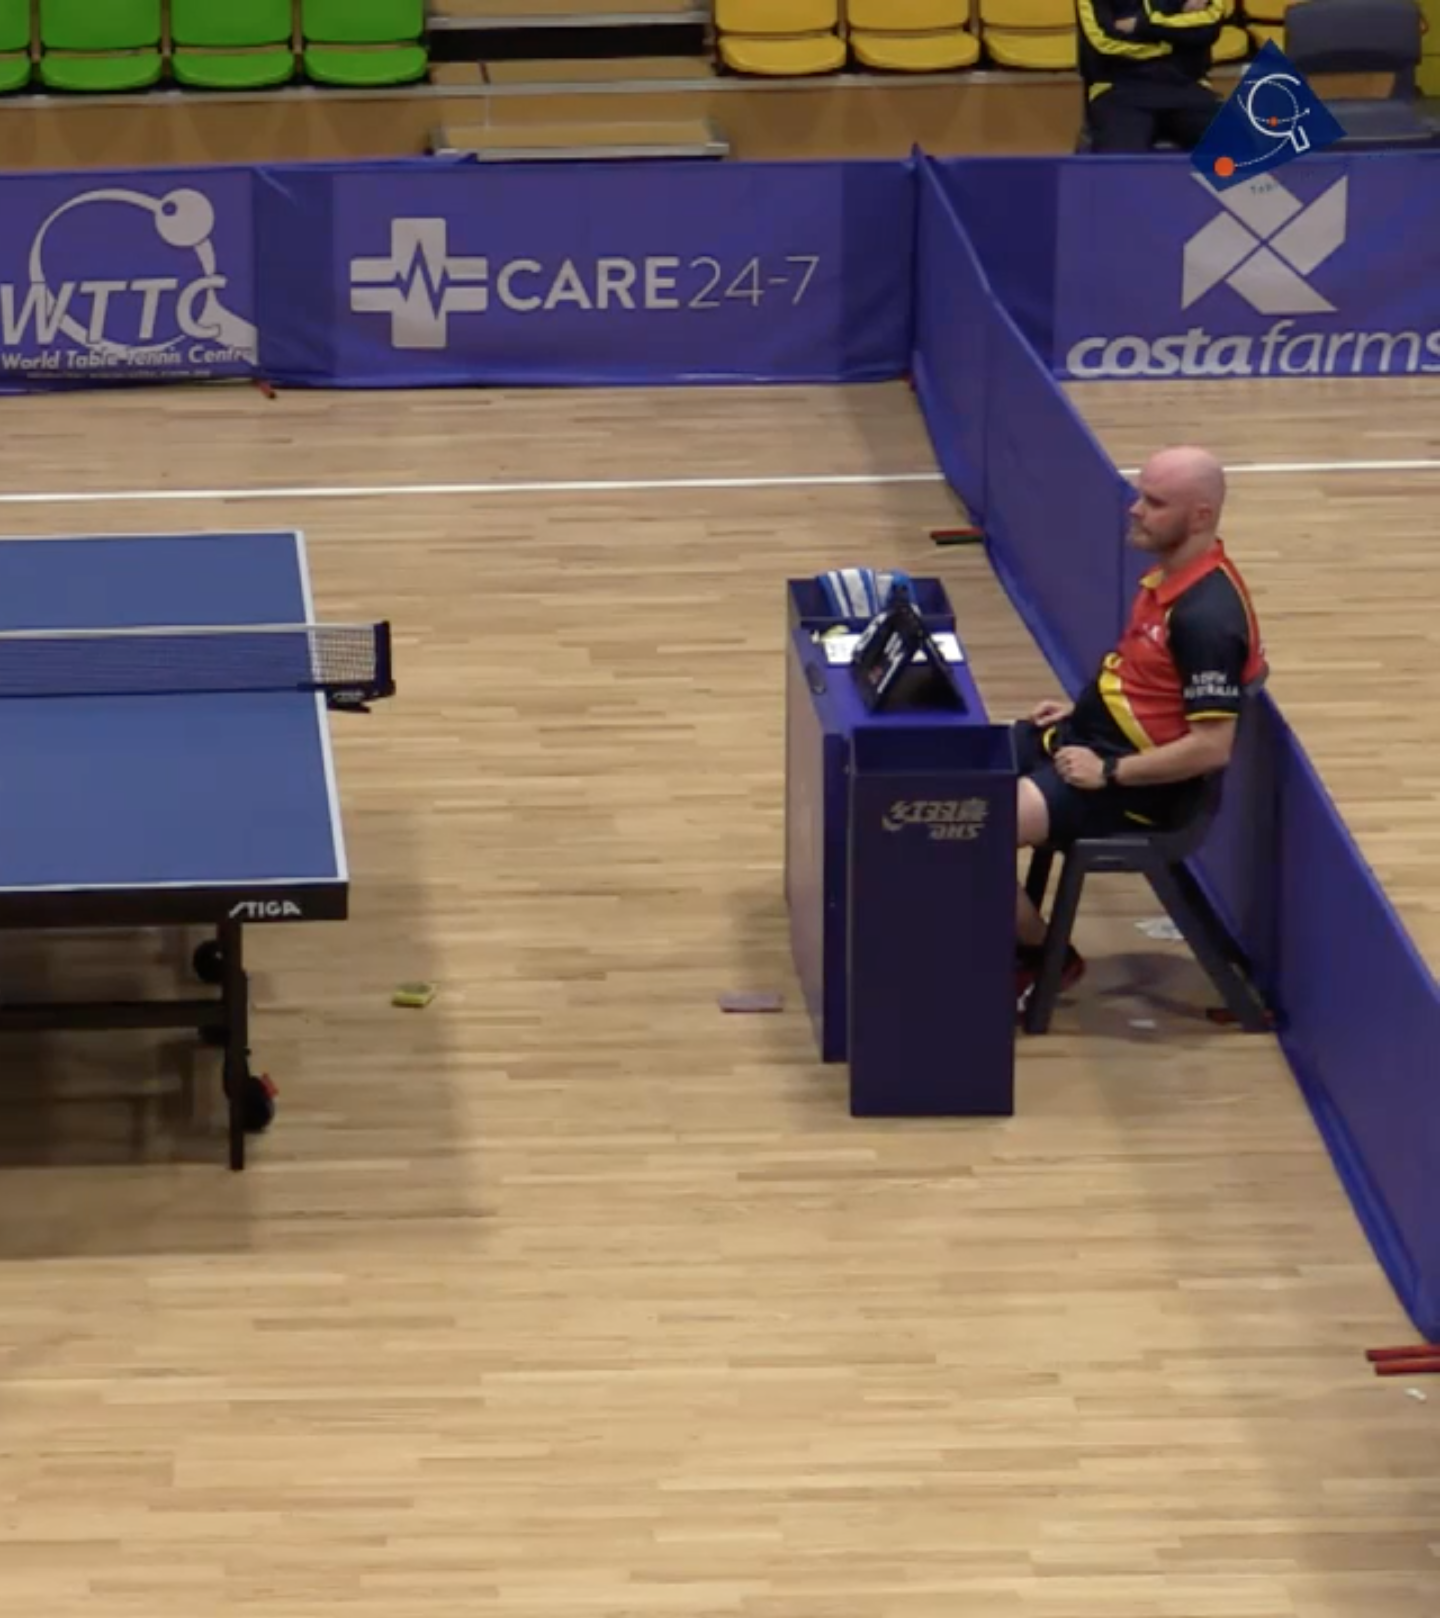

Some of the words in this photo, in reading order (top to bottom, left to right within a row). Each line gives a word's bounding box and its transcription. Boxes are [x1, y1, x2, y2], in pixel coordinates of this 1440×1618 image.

[0, 274, 228, 346] WTTC
[1, 351, 60, 371] World
[66, 349, 118, 369] Table
[126, 347, 182, 366] Tennis
[228, 900, 302, 918] STIGA
